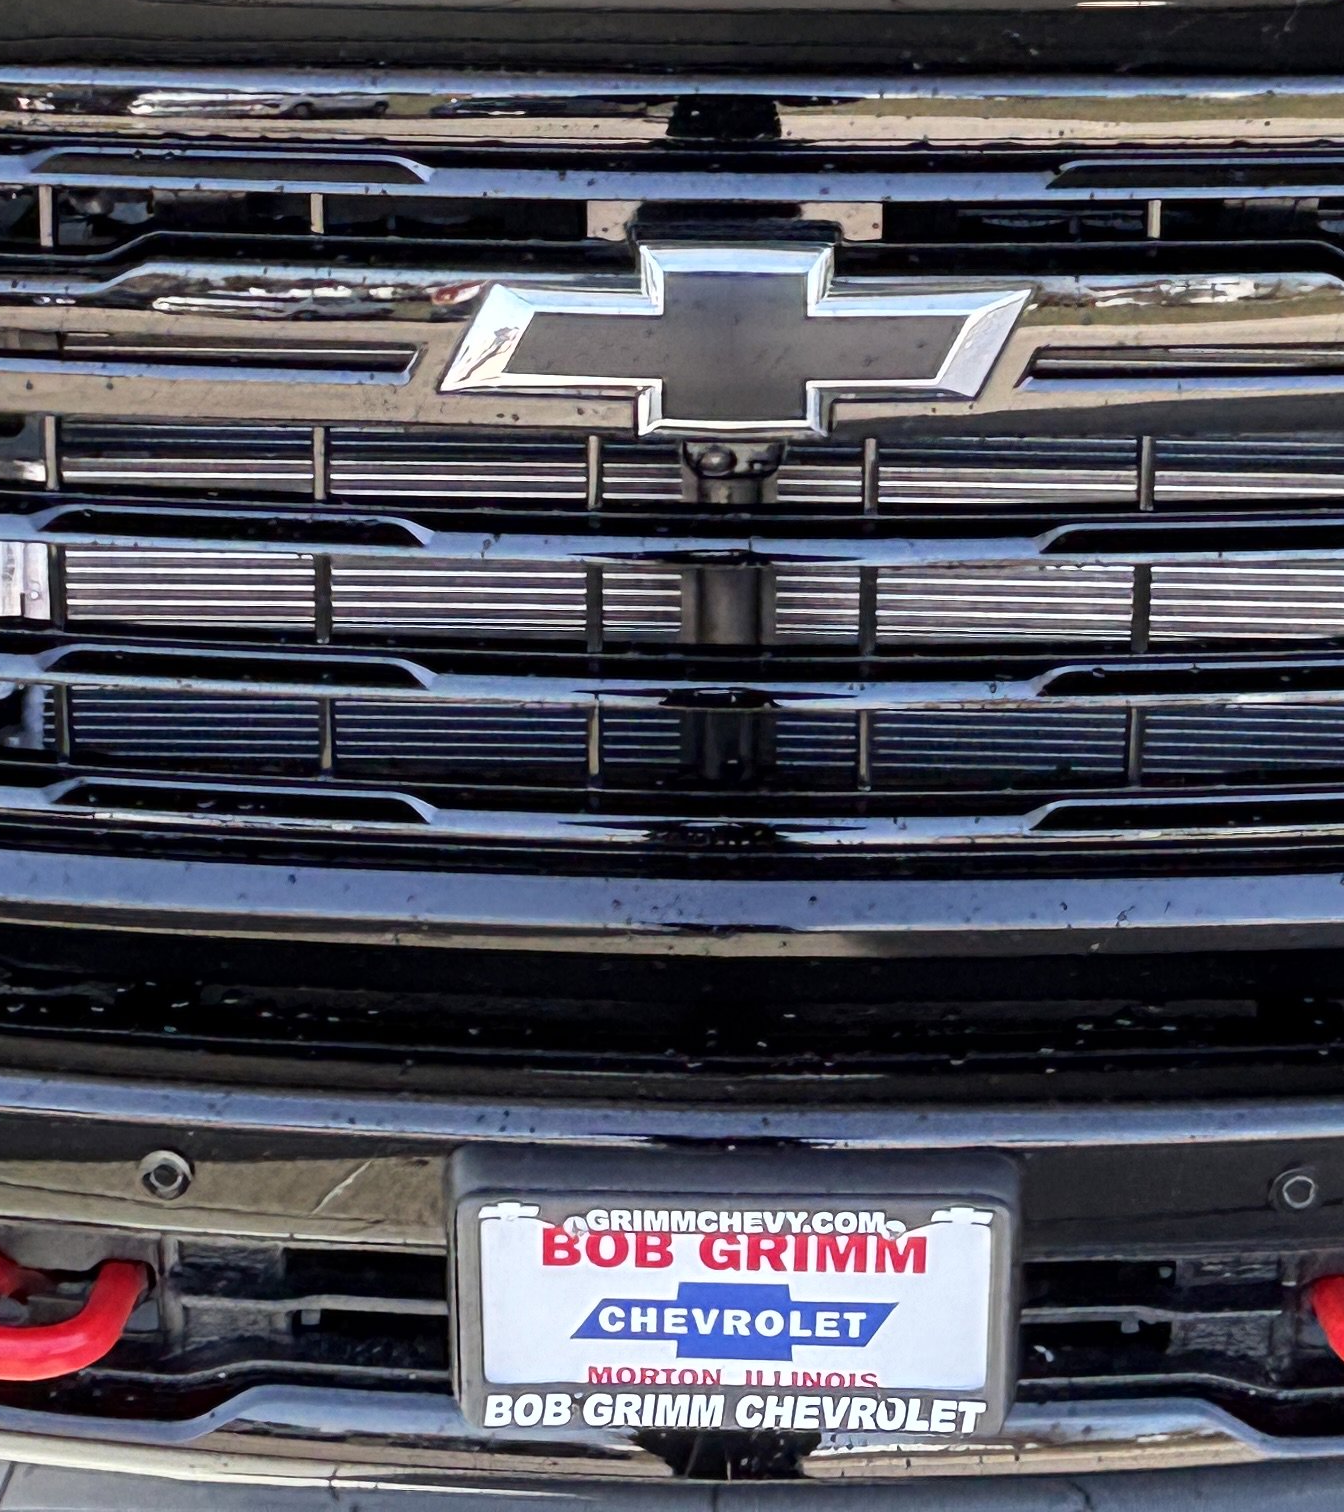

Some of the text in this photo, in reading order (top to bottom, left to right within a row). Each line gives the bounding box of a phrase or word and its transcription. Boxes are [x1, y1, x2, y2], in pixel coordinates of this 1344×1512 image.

[585, 1208, 888, 1235] GRIMMCHEVY.COM
[541, 1227, 928, 1275] BOB GRIMM
[597, 1304, 868, 1339] CHEVROLET
[483, 1392, 988, 1436] BOB GRIMM CHEVROLET
